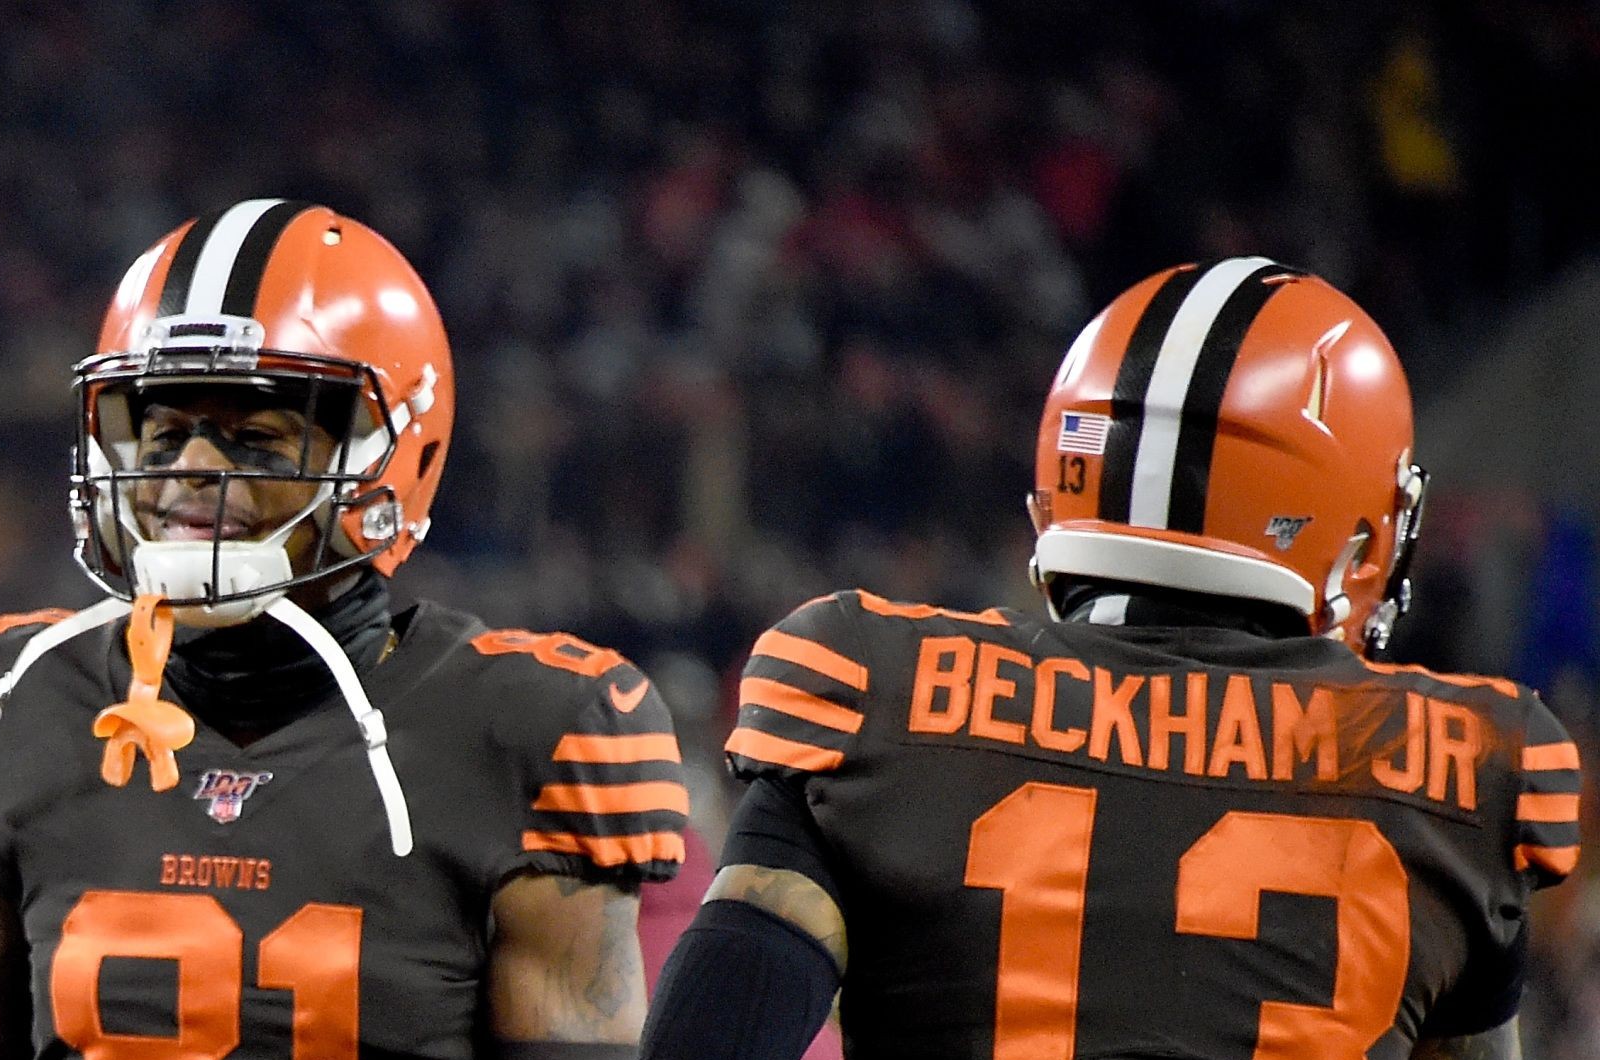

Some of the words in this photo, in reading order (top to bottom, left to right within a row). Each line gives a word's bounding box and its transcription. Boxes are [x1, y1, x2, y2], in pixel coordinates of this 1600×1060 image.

[1057, 454, 1087, 495] 13
[908, 635, 1340, 782] BECKHAM
[1371, 690, 1484, 811] JR
[160, 853, 272, 891] BROWNS
